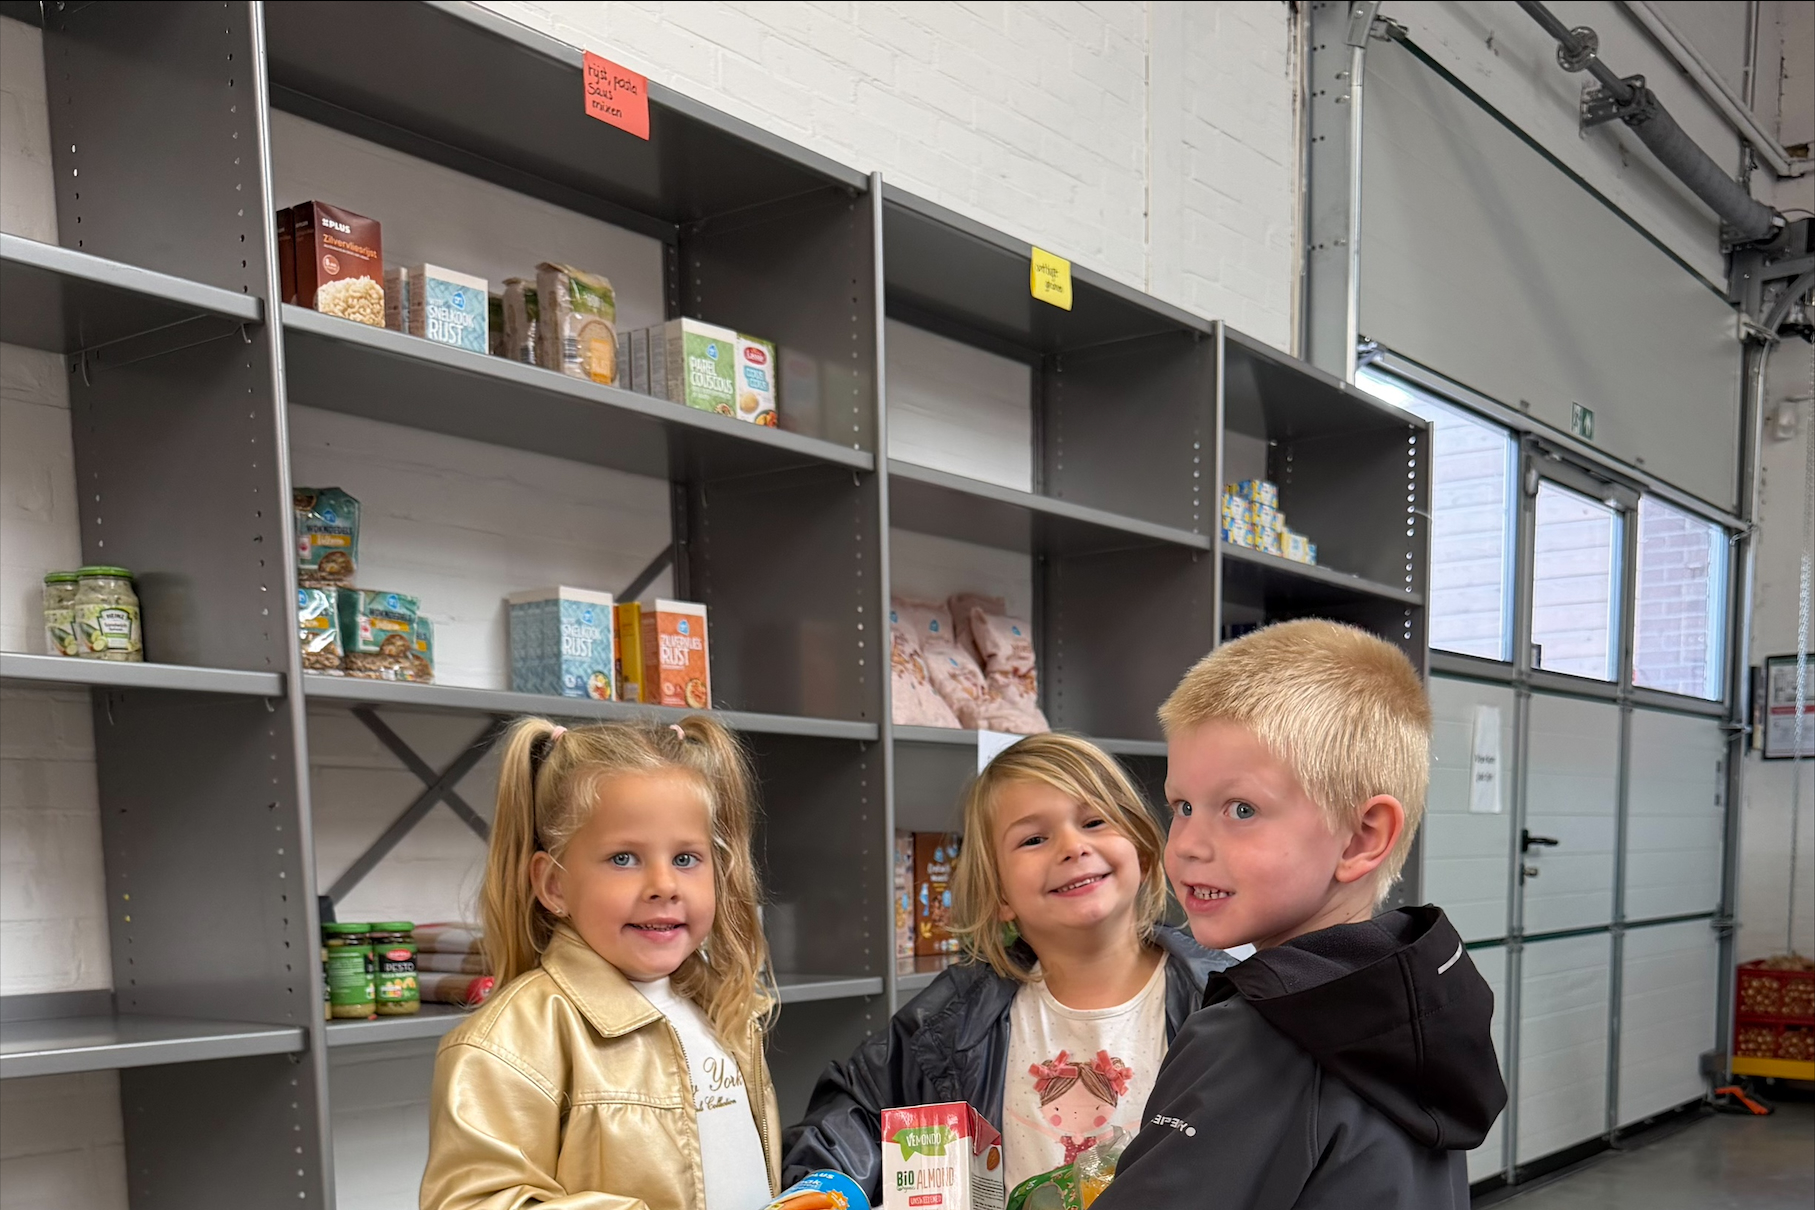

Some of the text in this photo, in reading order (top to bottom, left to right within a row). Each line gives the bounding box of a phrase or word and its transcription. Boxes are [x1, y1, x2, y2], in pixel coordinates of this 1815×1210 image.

[329, 219, 351, 234] PLUS
[691, 371, 734, 394] COUSCOUS
[906, 1131, 942, 1147] VEMONDO
[916, 1166, 955, 1190] ALMOND
